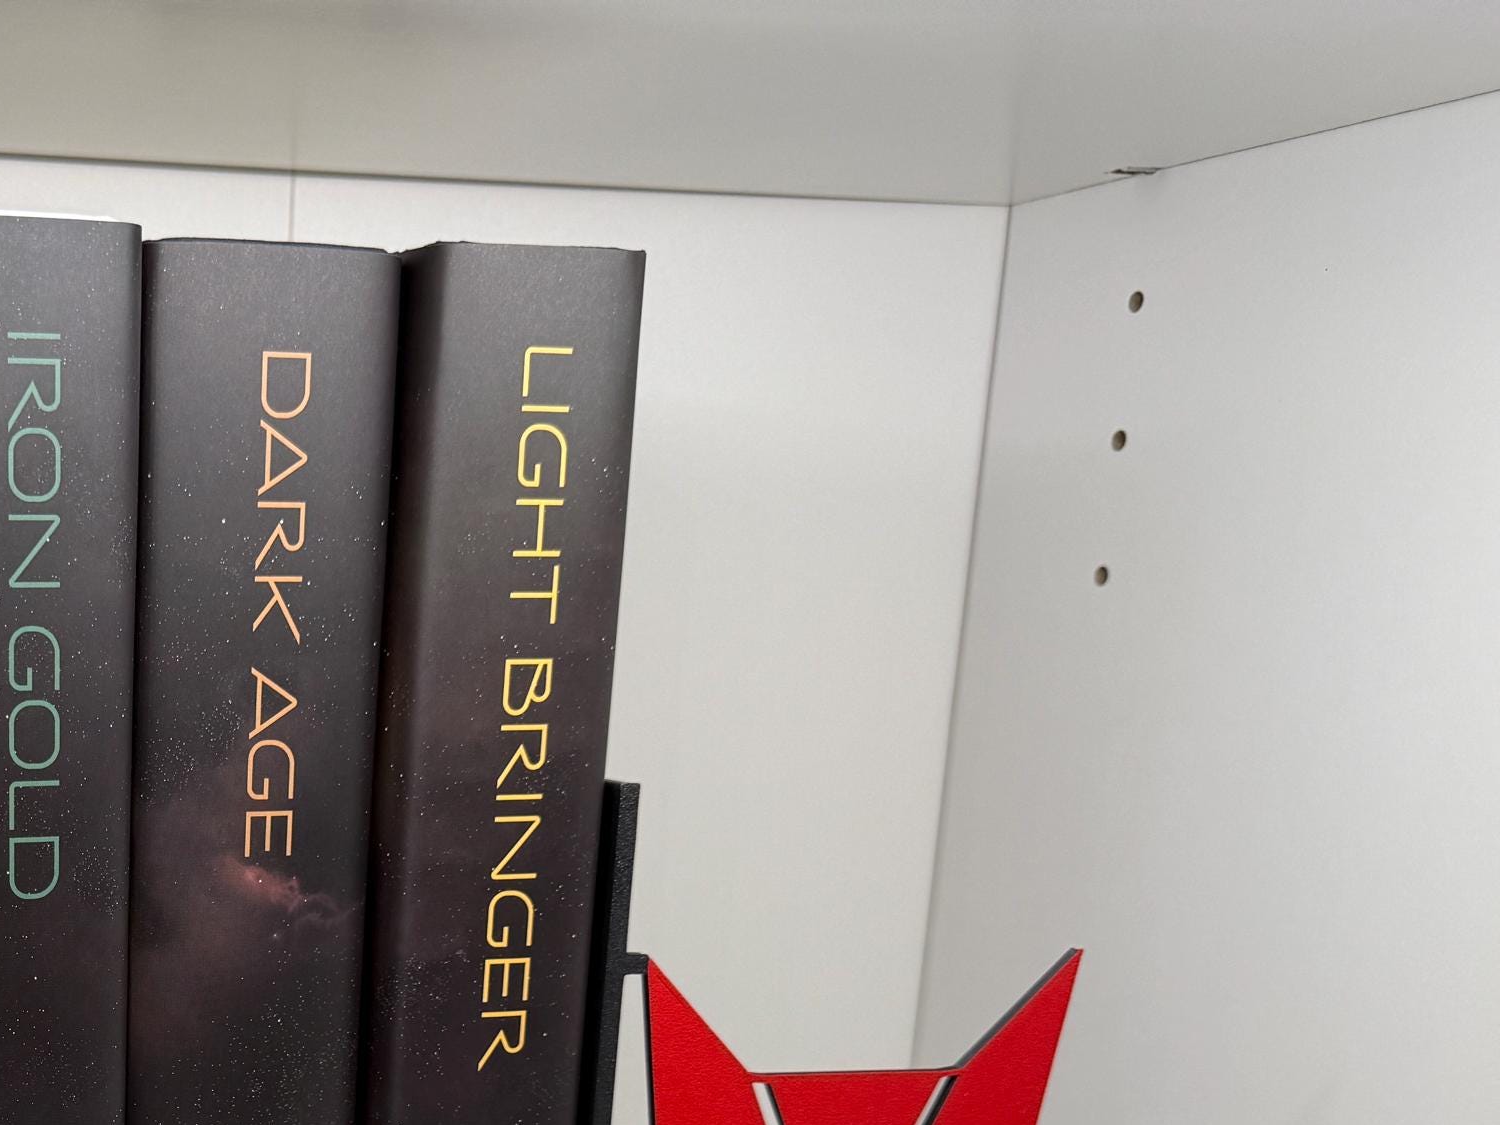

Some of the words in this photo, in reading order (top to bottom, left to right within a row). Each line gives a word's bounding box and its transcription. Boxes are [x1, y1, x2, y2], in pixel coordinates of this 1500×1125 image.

[7, 331, 61, 589] IRON
[252, 350, 312, 645] DARK
[509, 346, 574, 624] LIGHT
[8, 625, 61, 900] GOLD
[243, 666, 298, 858] AGE
[477, 658, 553, 1072] BRINGER
